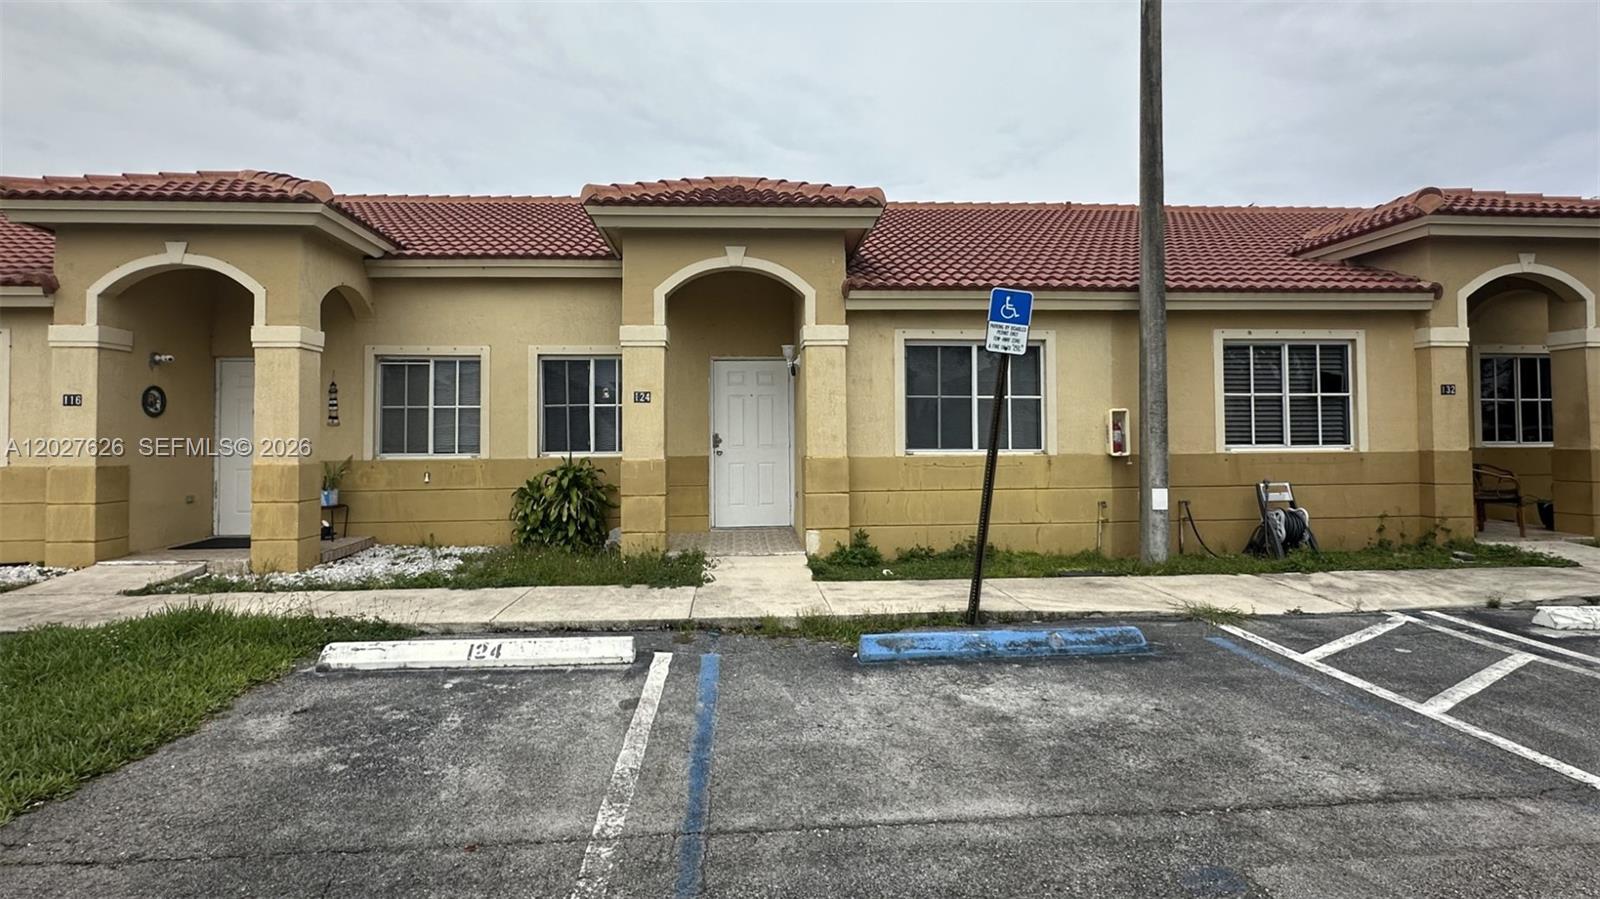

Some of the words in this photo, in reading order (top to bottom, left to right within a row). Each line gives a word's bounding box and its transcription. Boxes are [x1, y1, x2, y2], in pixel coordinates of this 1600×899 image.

[1441, 385, 1456, 395] 132
[63, 395, 82, 406] 116
[634, 391, 651, 402] 124
[467, 643, 502, 661] 124
